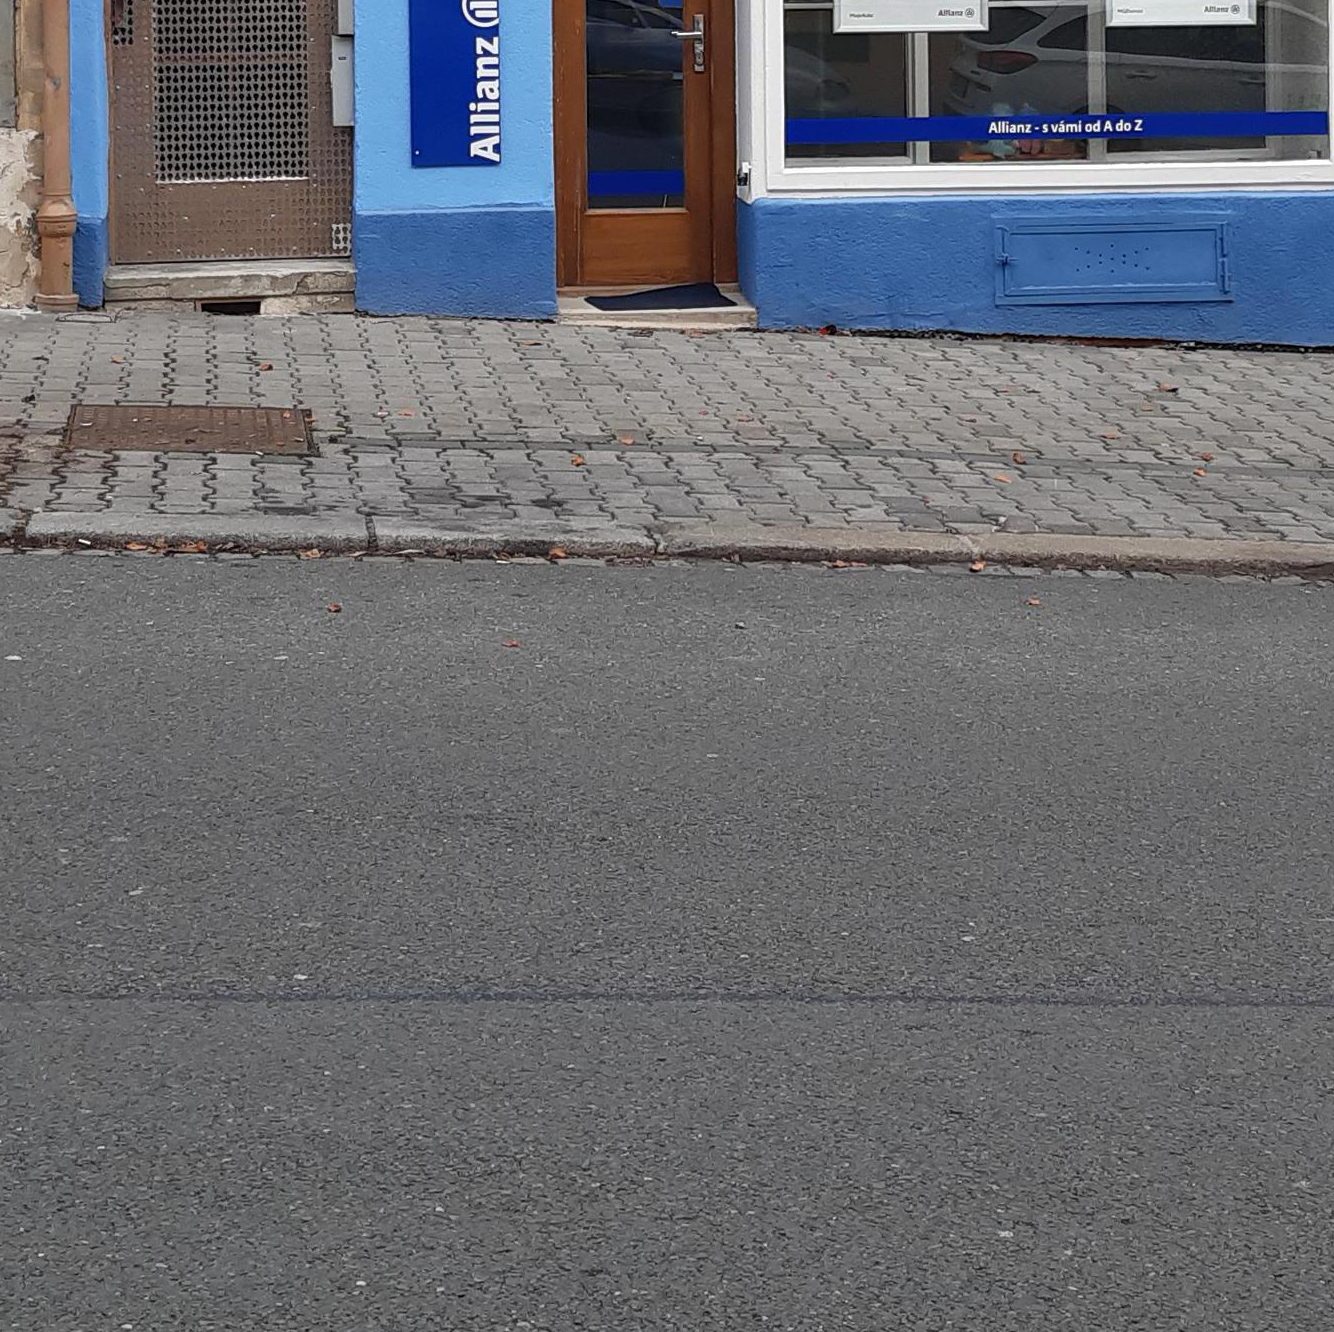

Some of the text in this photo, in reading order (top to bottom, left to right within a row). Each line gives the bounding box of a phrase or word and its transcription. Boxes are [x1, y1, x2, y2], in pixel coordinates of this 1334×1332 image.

[469, 36, 501, 163] Allianz
[988, 121, 1032, 134] Allianz
[1042, 124, 1048, 133] s
[1051, 121, 1082, 133] vámi
[1085, 120, 1101, 133] od
[1103, 121, 1113, 132] A
[1116, 120, 1132, 132] do
[1134, 120, 1143, 131] Z
